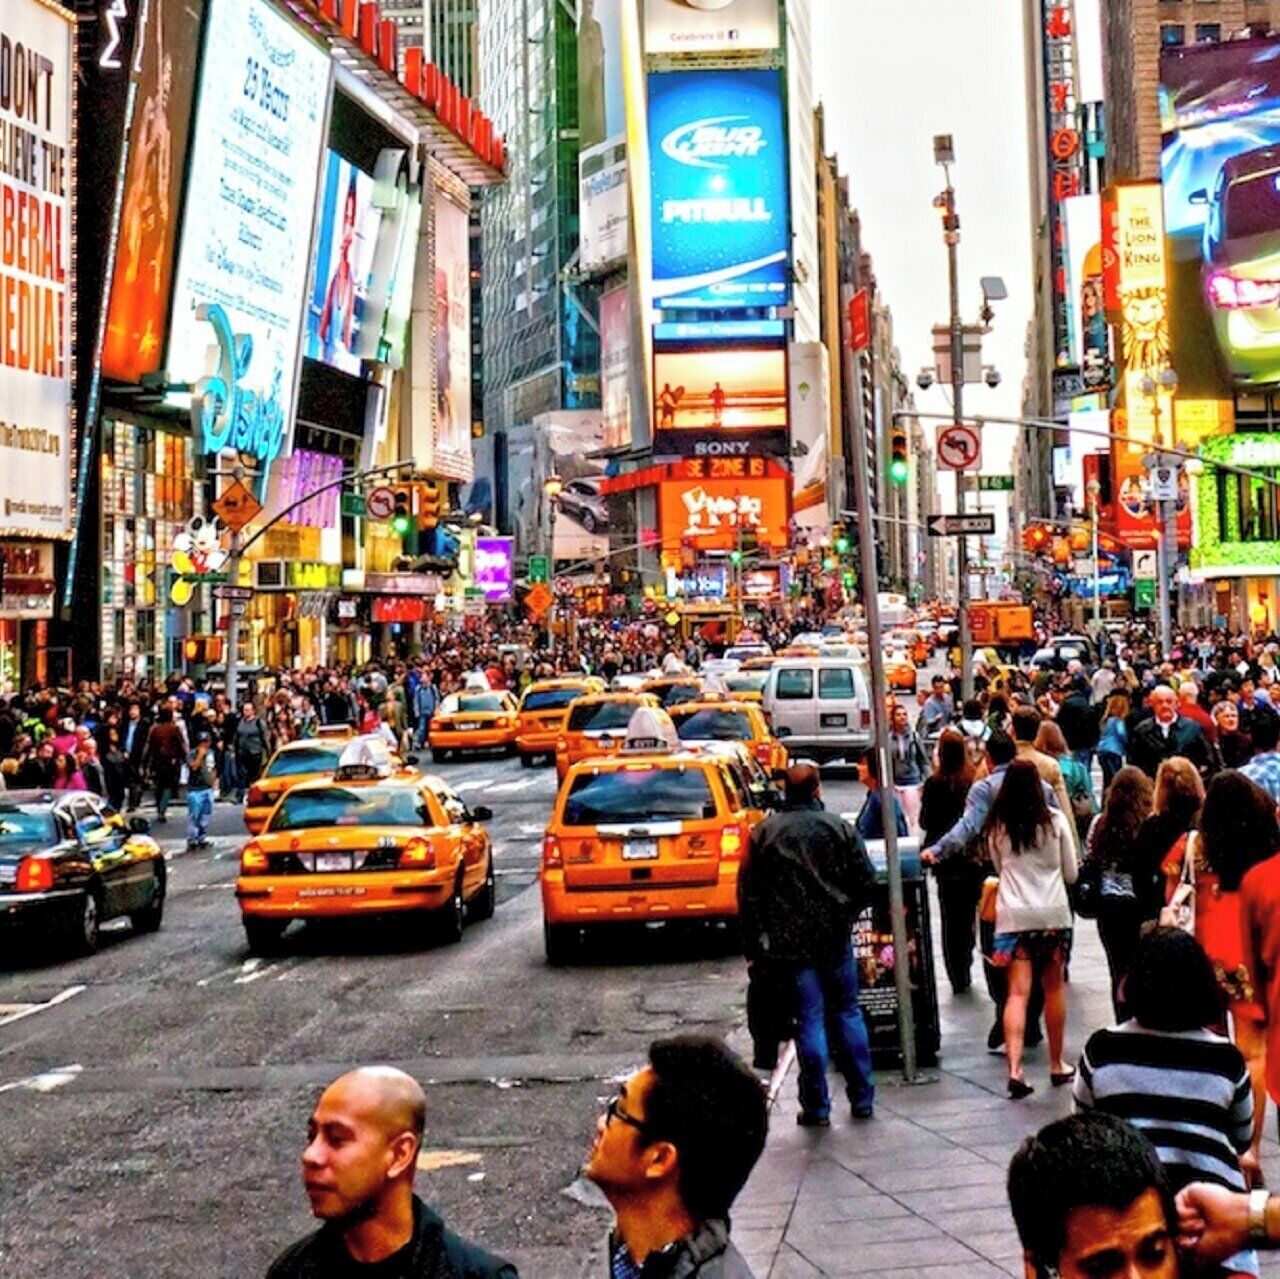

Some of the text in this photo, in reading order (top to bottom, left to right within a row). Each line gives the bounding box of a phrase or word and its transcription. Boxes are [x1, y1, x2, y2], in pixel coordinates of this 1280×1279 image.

[0, 32, 54, 132] DON'T
[690, 125, 762, 142] BUD
[682, 140, 768, 158] LIGHT
[42, 141, 66, 197] THE
[662, 196, 772, 223] PITBULL
[1129, 214, 1151, 228] THE
[1124, 231, 1157, 247] LION
[1124, 249, 1162, 268] KING
[695, 442, 750, 455] SONY
